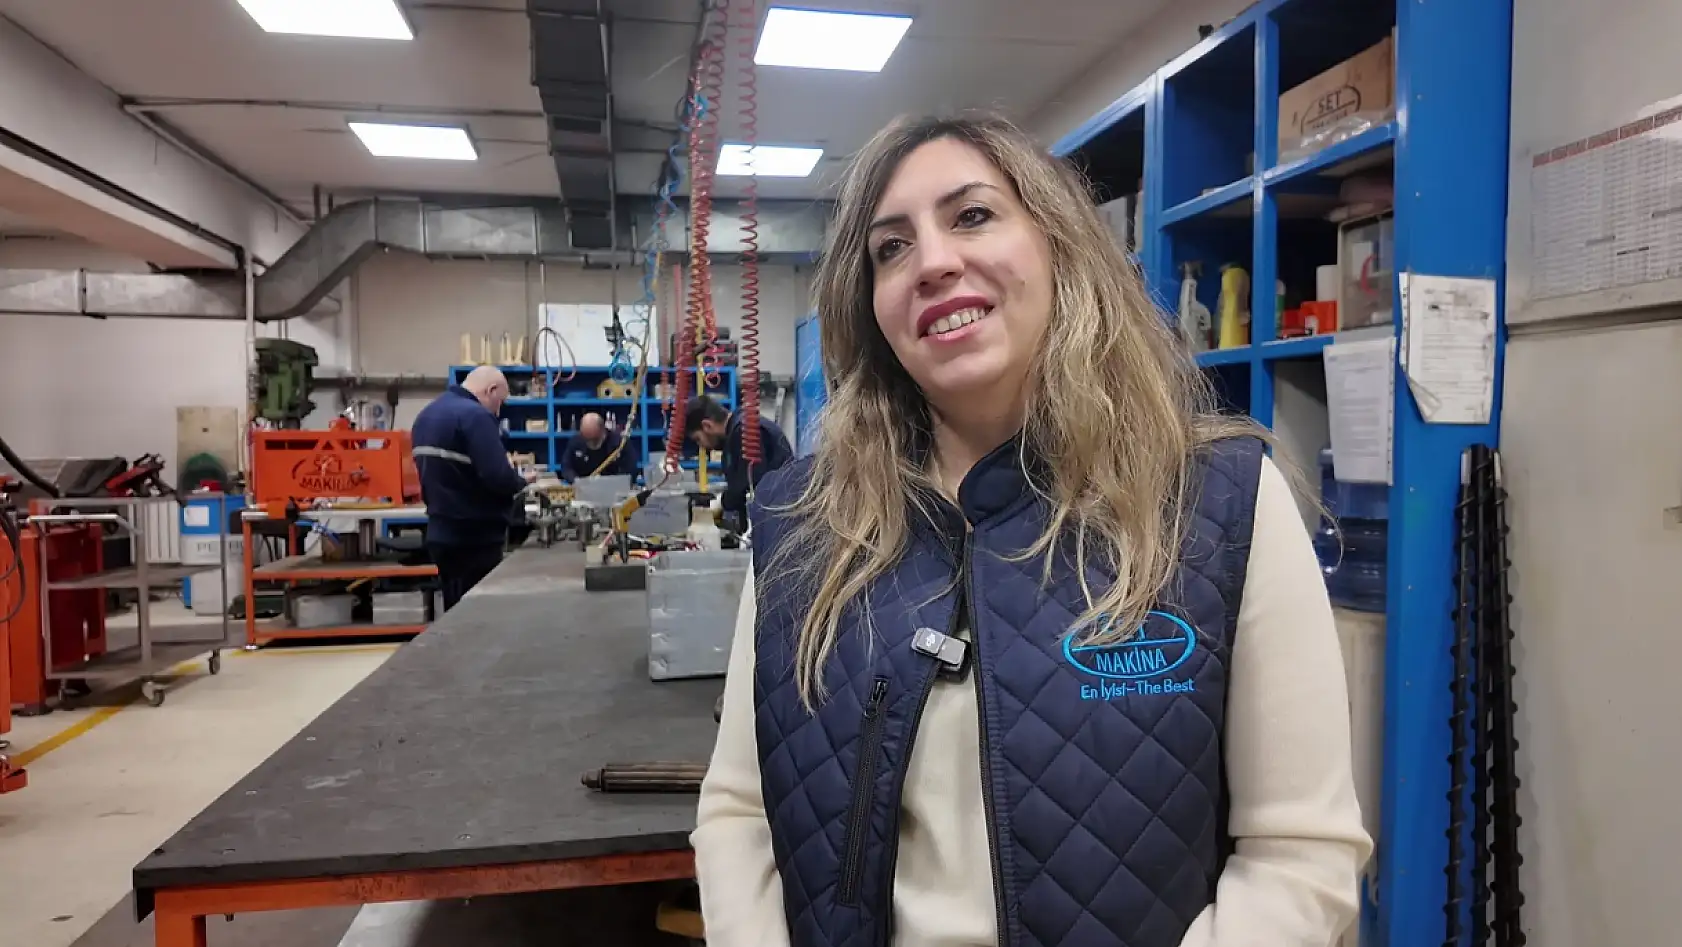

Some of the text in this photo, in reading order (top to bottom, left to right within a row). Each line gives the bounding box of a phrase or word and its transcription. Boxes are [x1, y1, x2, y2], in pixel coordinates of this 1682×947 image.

[1318, 90, 1342, 114] SET
[1080, 684, 1098, 699] En
[1163, 678, 1195, 693] Best
